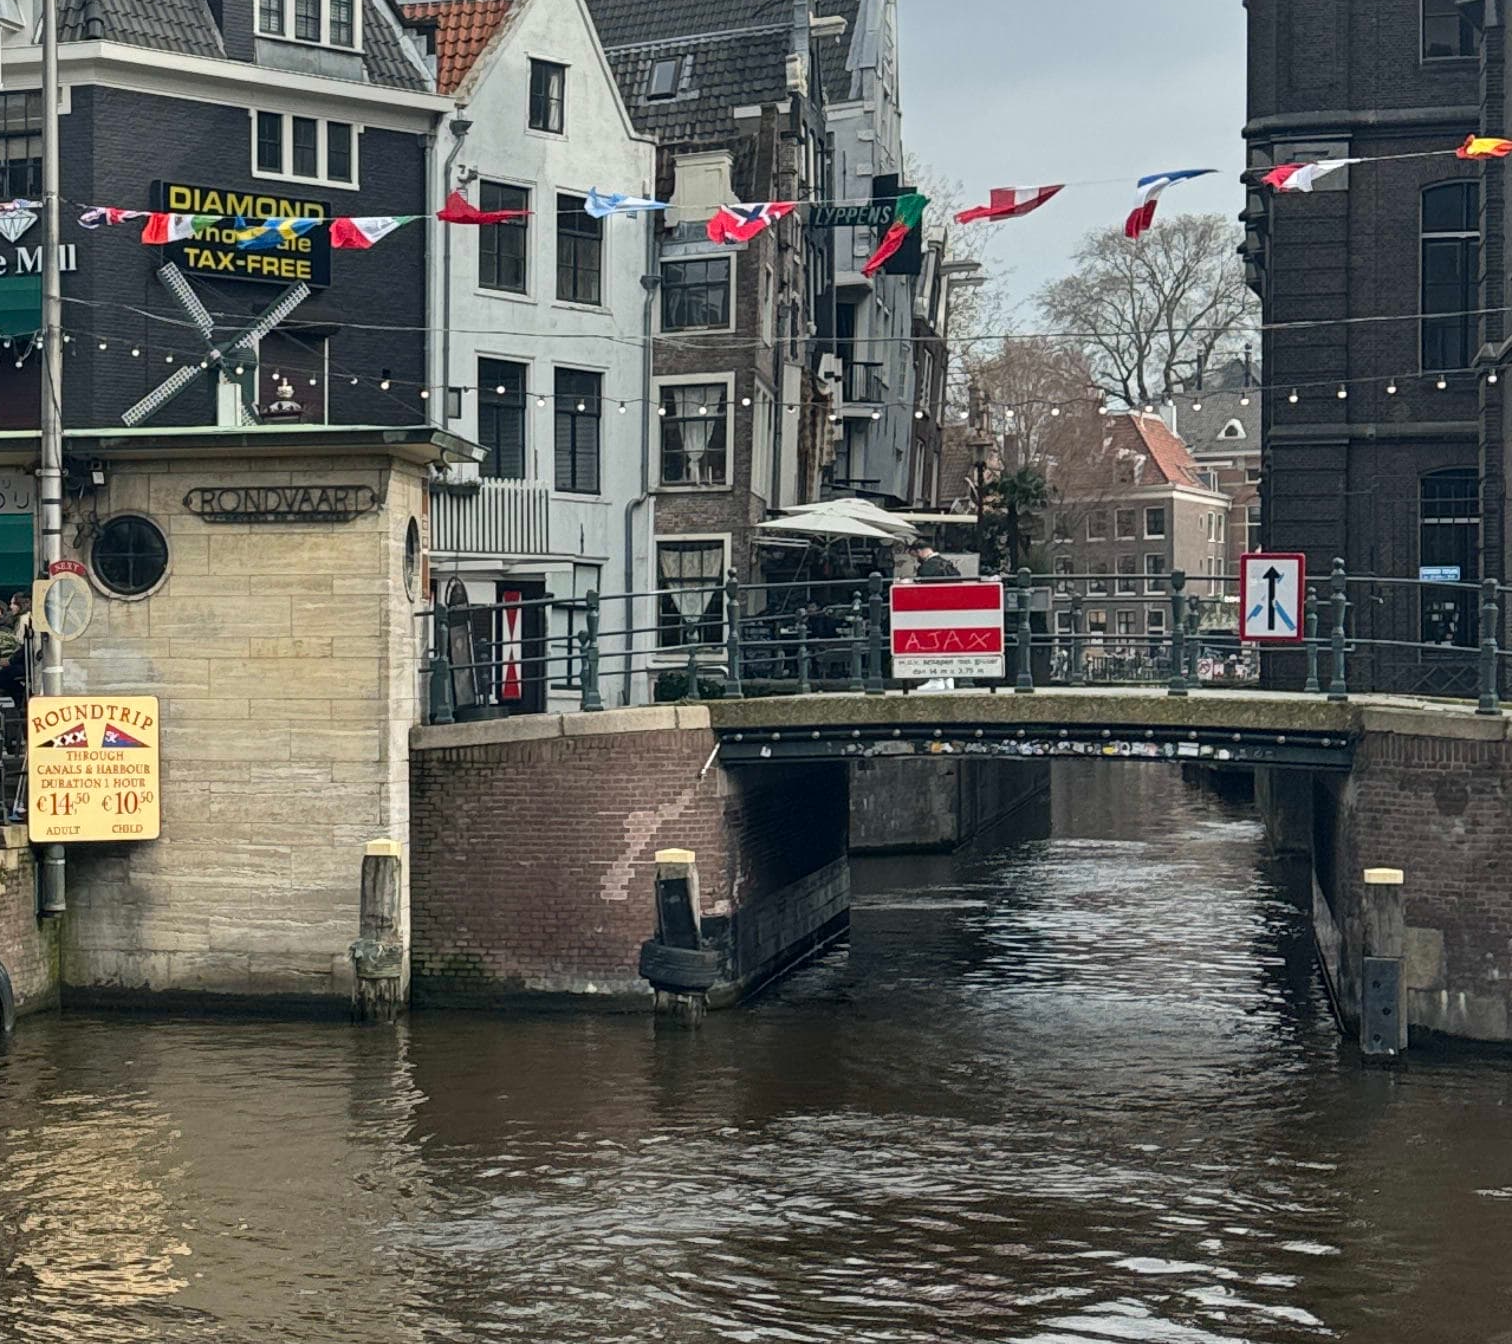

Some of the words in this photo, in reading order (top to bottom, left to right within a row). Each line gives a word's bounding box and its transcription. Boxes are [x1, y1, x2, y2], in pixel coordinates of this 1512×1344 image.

[169, 185, 325, 225] DIAMOND
[815, 206, 892, 225] LYPPENS
[15, 243, 77, 274] Mll
[183, 247, 312, 279] TAX-FREE
[905, 630, 992, 650] AJAX
[31, 703, 154, 734] ROUNDTRIP
[66, 750, 124, 762] THROUGH
[37, 765, 82, 775] CANALS
[85, 765, 93, 775] &
[97, 764, 151, 775] HARBOUR
[41, 778, 102, 789] DURATION
[113, 778, 146, 788] HOUR
[46, 826, 81, 836] ADULT
[112, 824, 144, 834] CHILD
